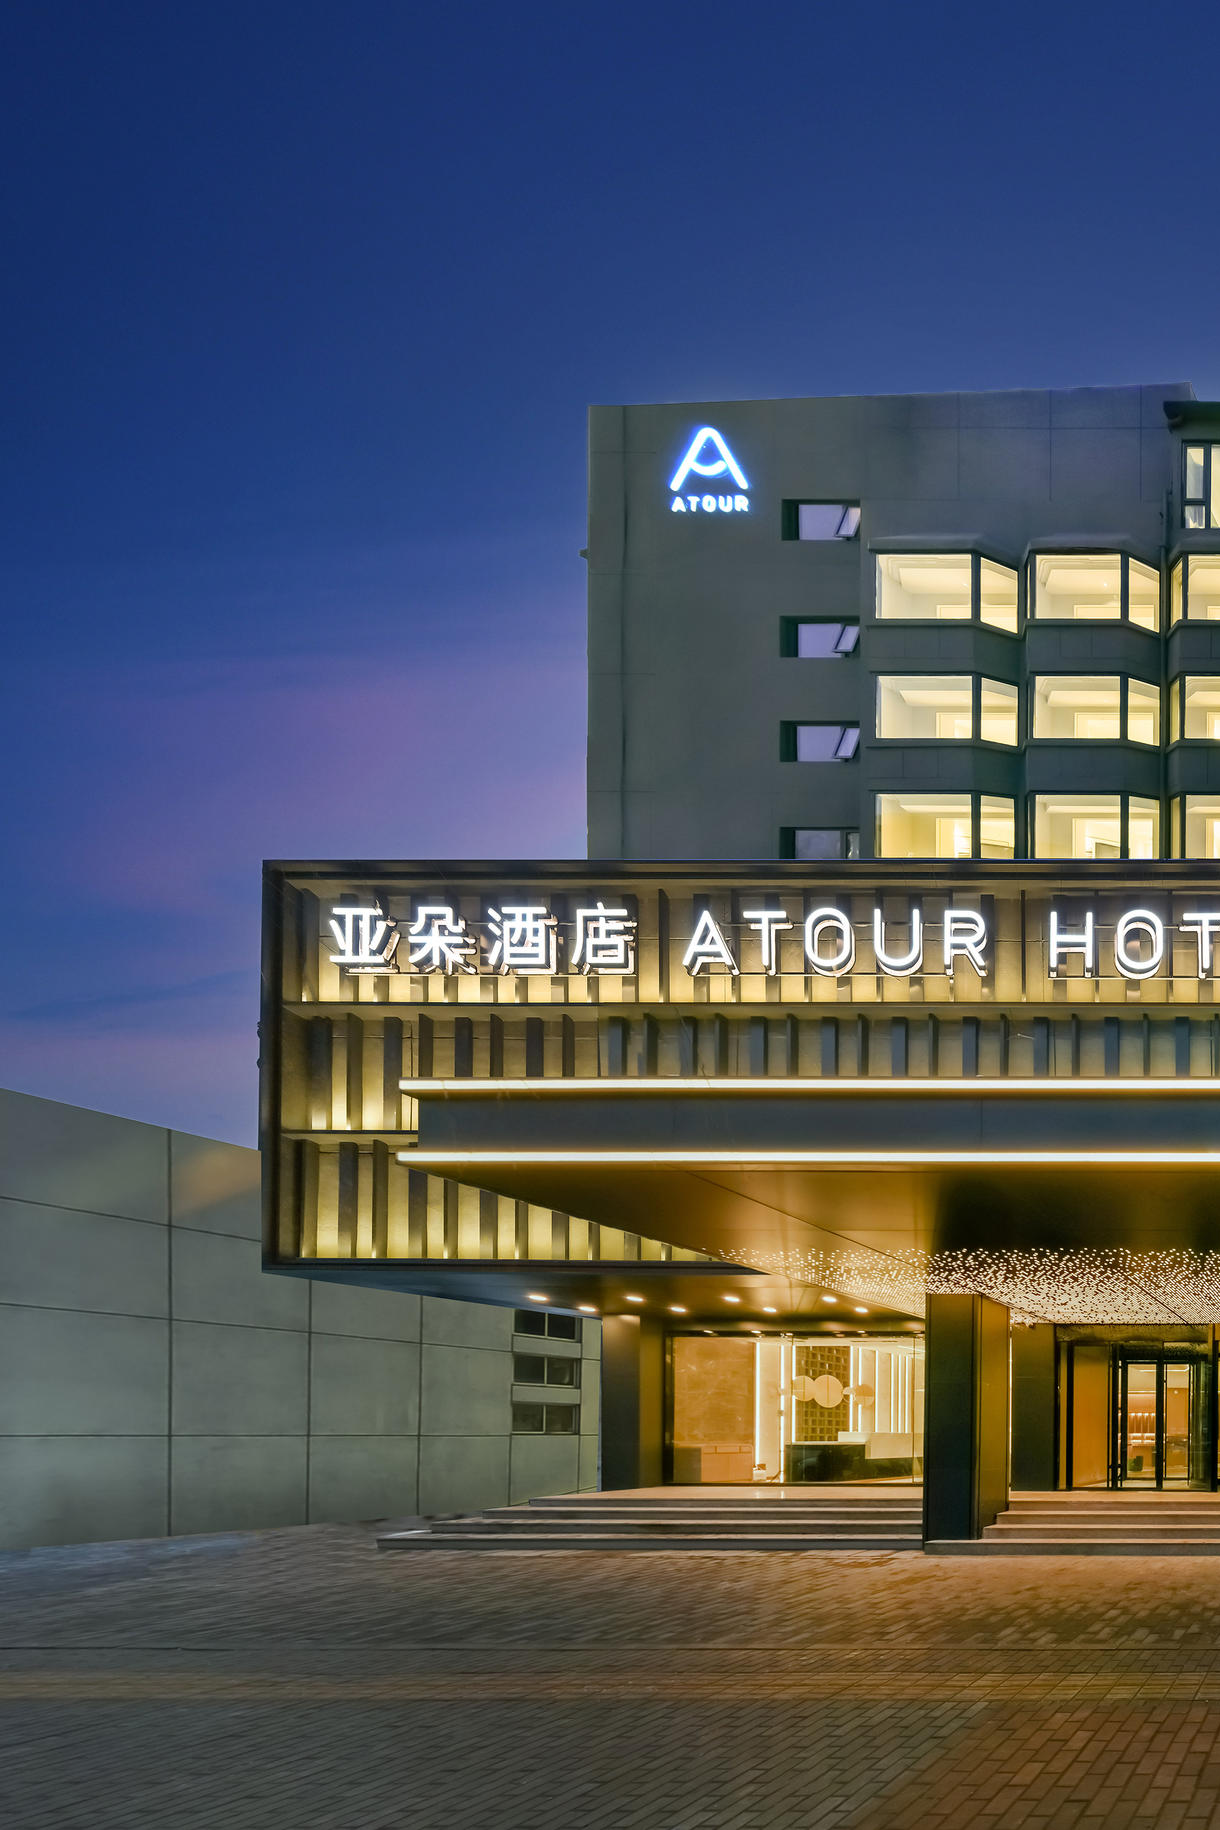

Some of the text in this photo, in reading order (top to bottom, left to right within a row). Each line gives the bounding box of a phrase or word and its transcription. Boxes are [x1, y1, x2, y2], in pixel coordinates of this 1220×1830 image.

[671, 494, 749, 513] ATOUR
[329, 902, 630, 969] 亚朵酒店
[682, 907, 987, 972] ATOUR
